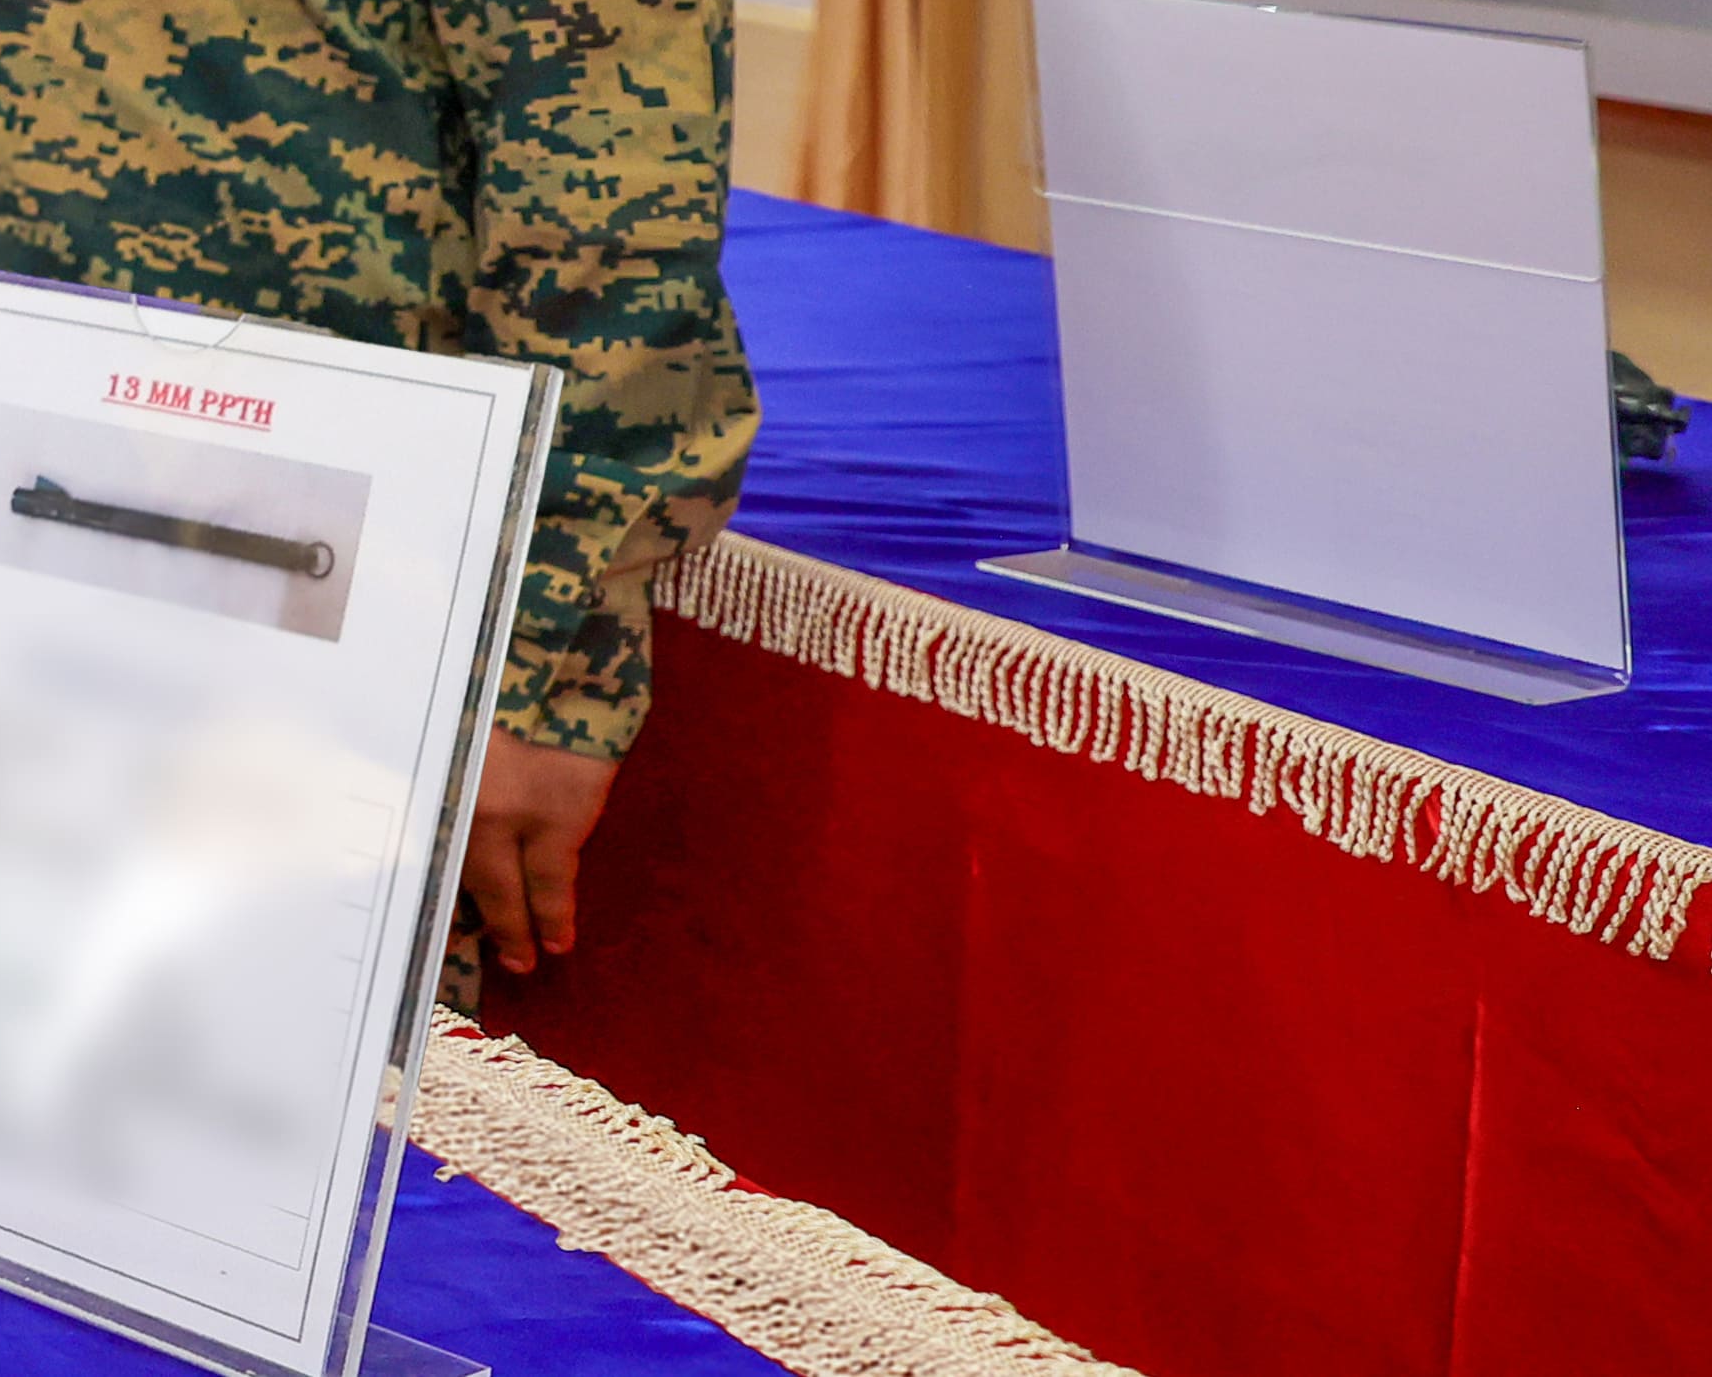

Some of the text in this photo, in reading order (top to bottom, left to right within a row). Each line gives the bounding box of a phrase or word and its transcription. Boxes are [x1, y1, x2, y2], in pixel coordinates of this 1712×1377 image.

[108, 373, 276, 426] 13 MM PPTH
